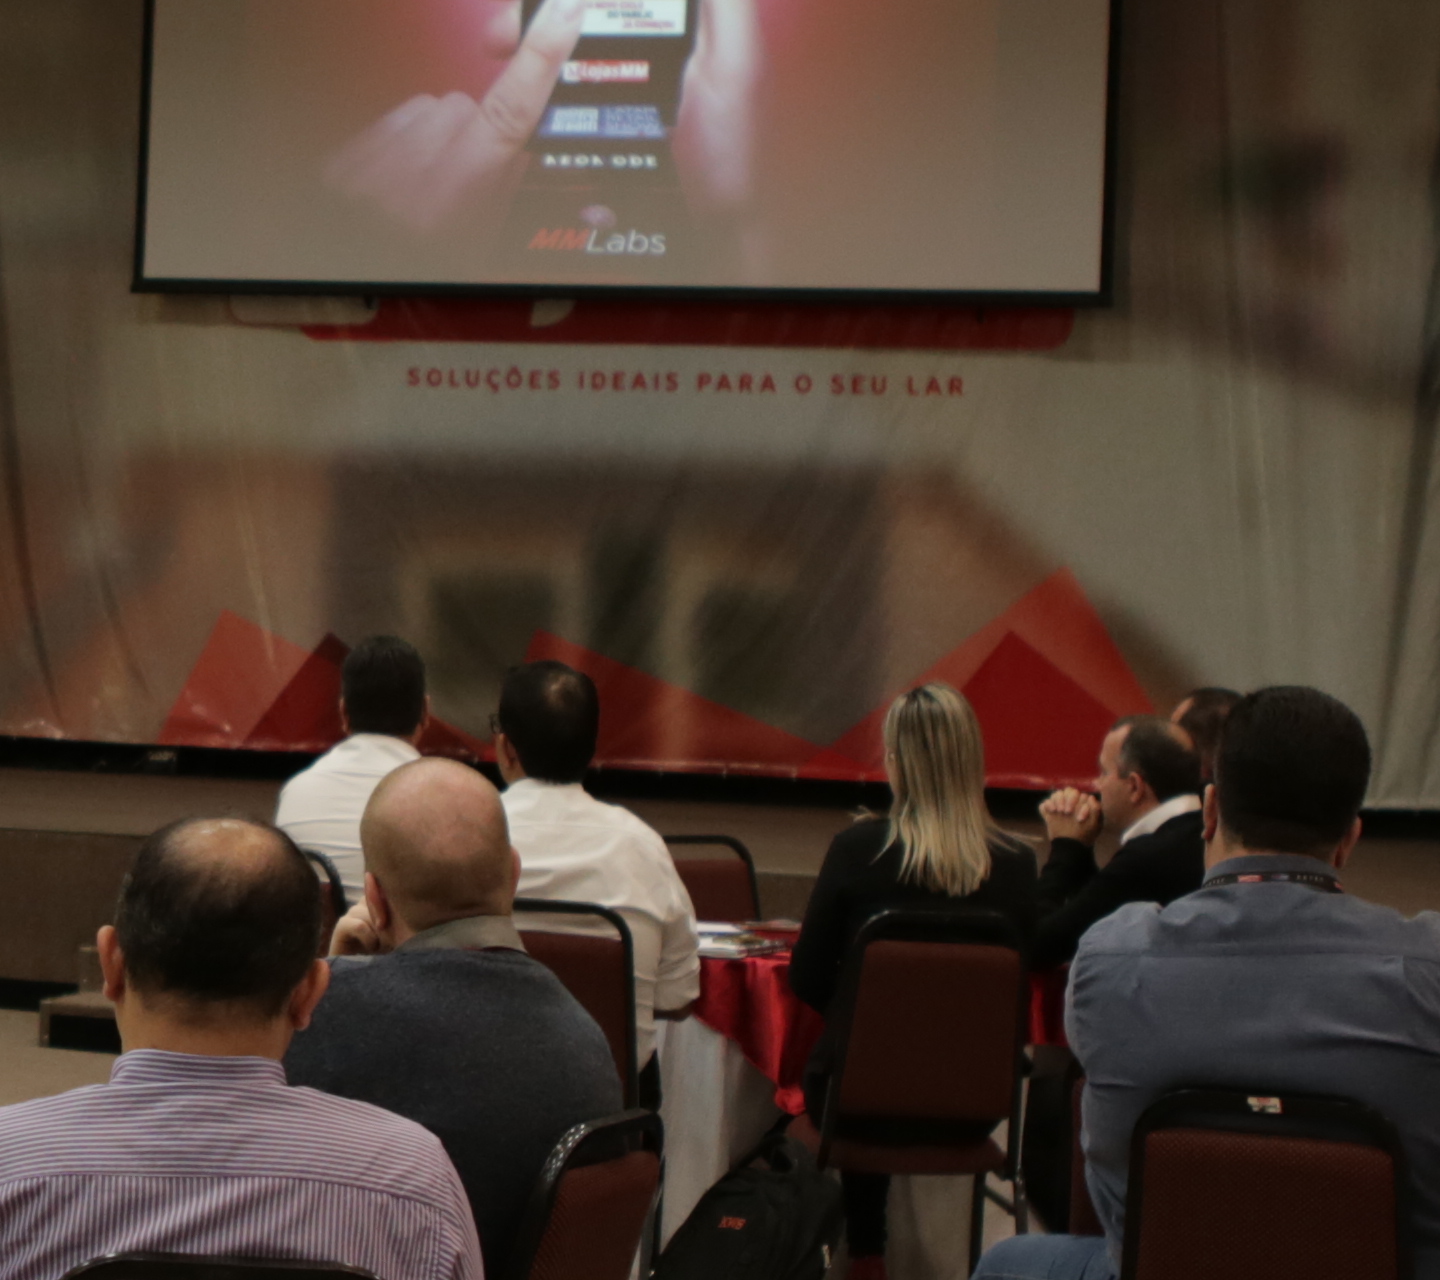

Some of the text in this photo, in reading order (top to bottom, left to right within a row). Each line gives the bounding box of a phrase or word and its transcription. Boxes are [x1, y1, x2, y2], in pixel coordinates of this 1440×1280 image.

[407, 366, 965, 397] SOLUÇÕES IDEAIS PARA O SEU LAR
